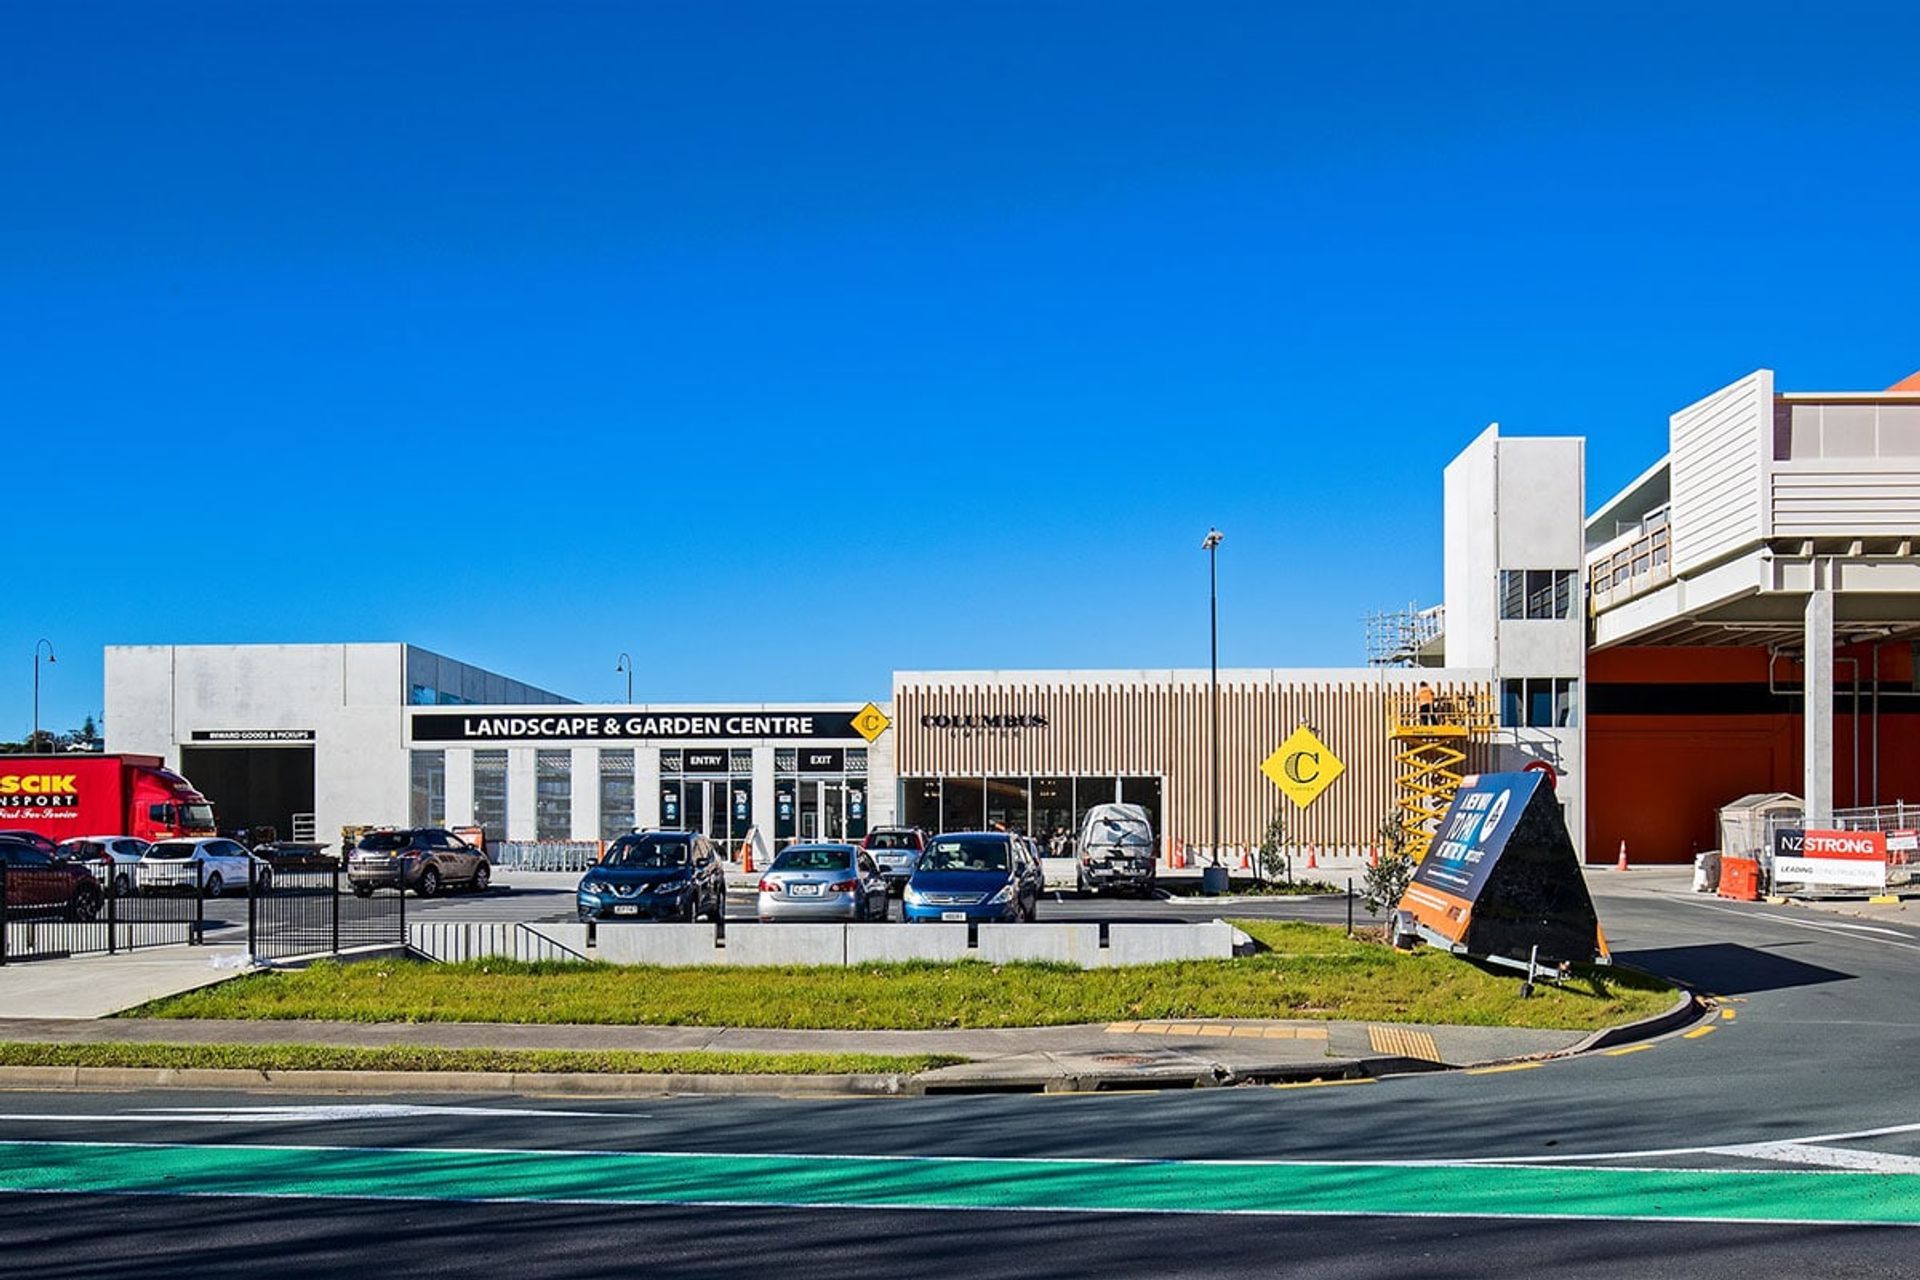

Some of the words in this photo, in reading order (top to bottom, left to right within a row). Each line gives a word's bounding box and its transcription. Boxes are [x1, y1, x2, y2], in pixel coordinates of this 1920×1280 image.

[464, 718, 599, 736] LANDSCAPE
[603, 718, 621, 735] &
[625, 717, 720, 735] GARDEN
[726, 717, 813, 734] CENTRE
[921, 715, 1049, 729] COLUMBUS
[689, 755, 722, 767] ENTRY
[809, 755, 832, 766] EXIT
[1285, 751, 1320, 784] C
[0, 775, 77, 793] SCIK
[1781, 866, 1814, 875] LEADING
